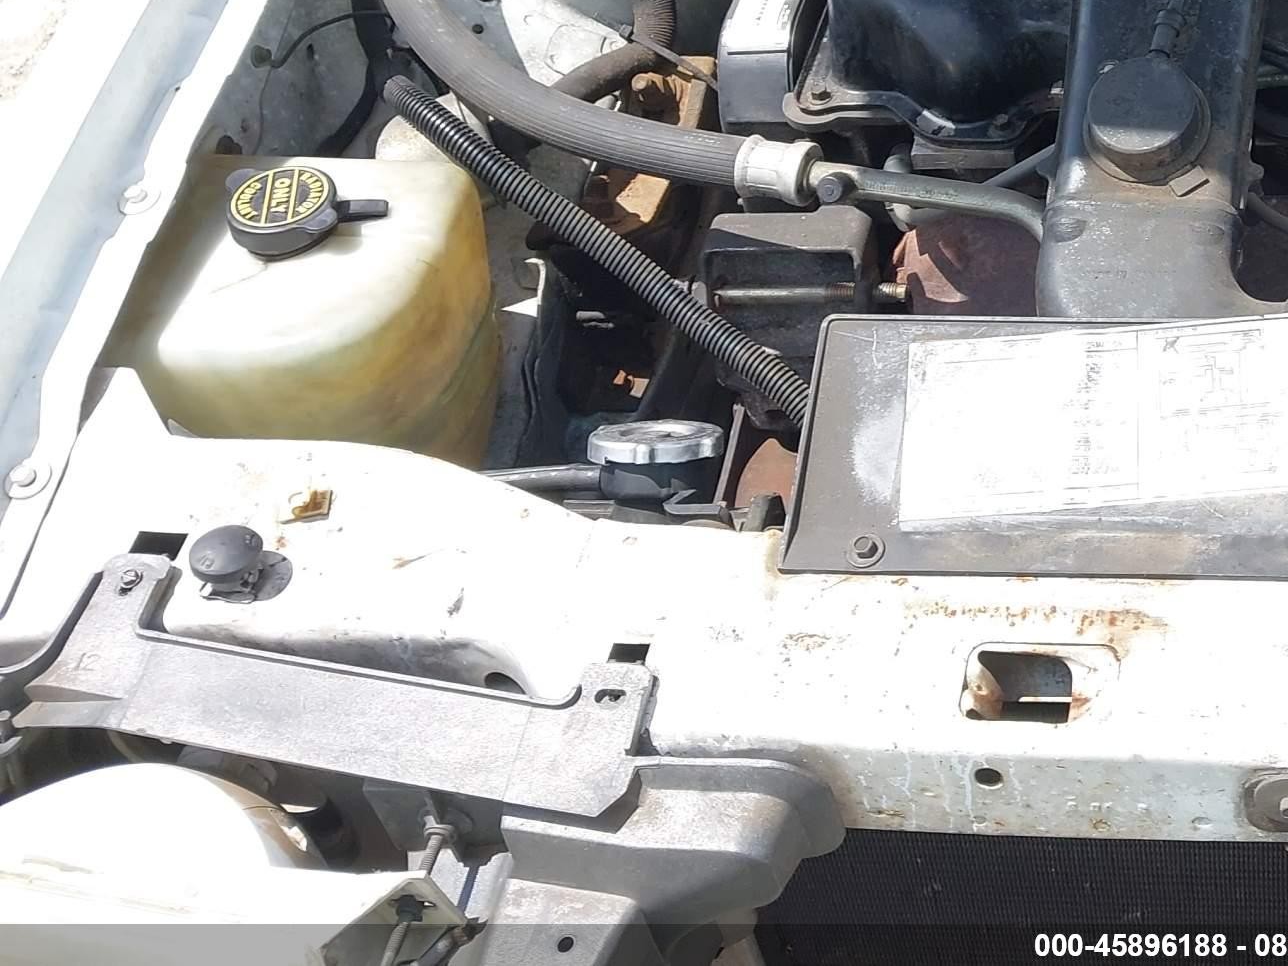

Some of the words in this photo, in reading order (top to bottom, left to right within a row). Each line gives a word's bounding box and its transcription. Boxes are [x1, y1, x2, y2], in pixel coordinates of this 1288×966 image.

[237, 181, 262, 220] COOLANT
[269, 177, 292, 214] ONLY
[299, 170, 322, 214] RADIATOR
